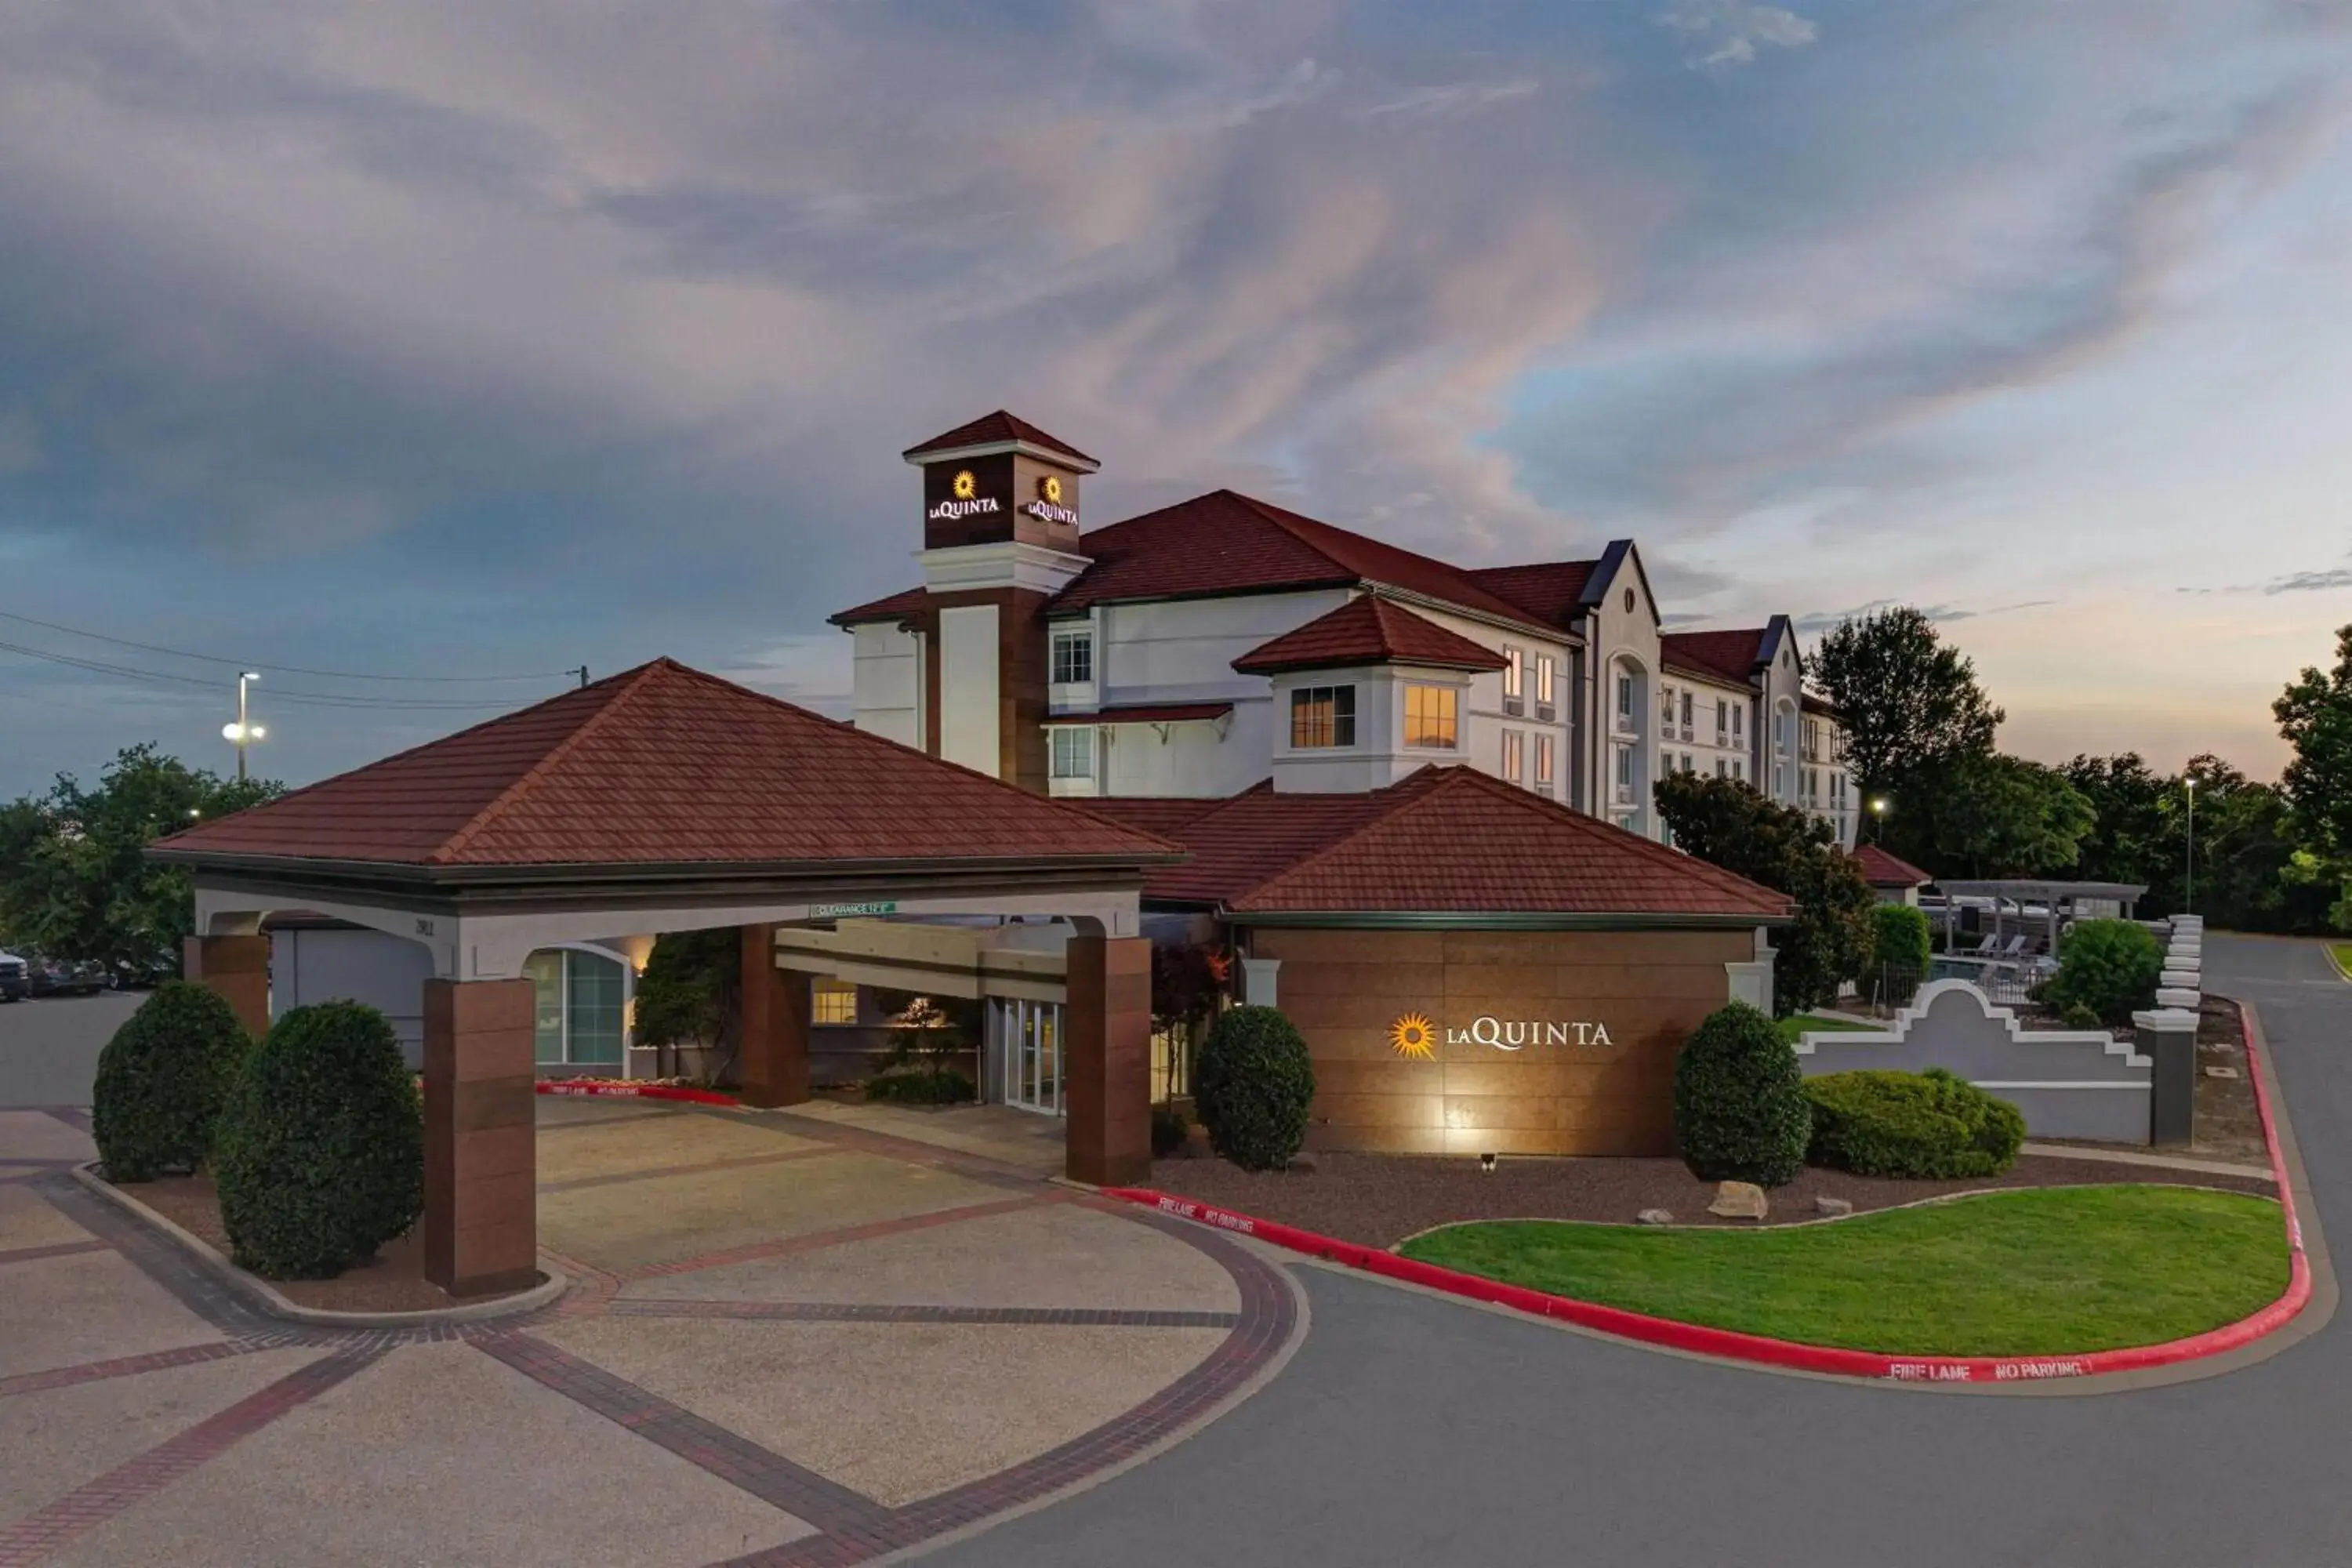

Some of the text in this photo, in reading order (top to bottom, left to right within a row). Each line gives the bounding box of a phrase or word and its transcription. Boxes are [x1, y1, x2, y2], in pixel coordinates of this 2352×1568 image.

[1472, 1016, 1613, 1051] QUINTA
[1176, 1203, 1197, 1218] LANE
[1890, 1361, 2083, 1381] FIRE LANE NO PARKING
